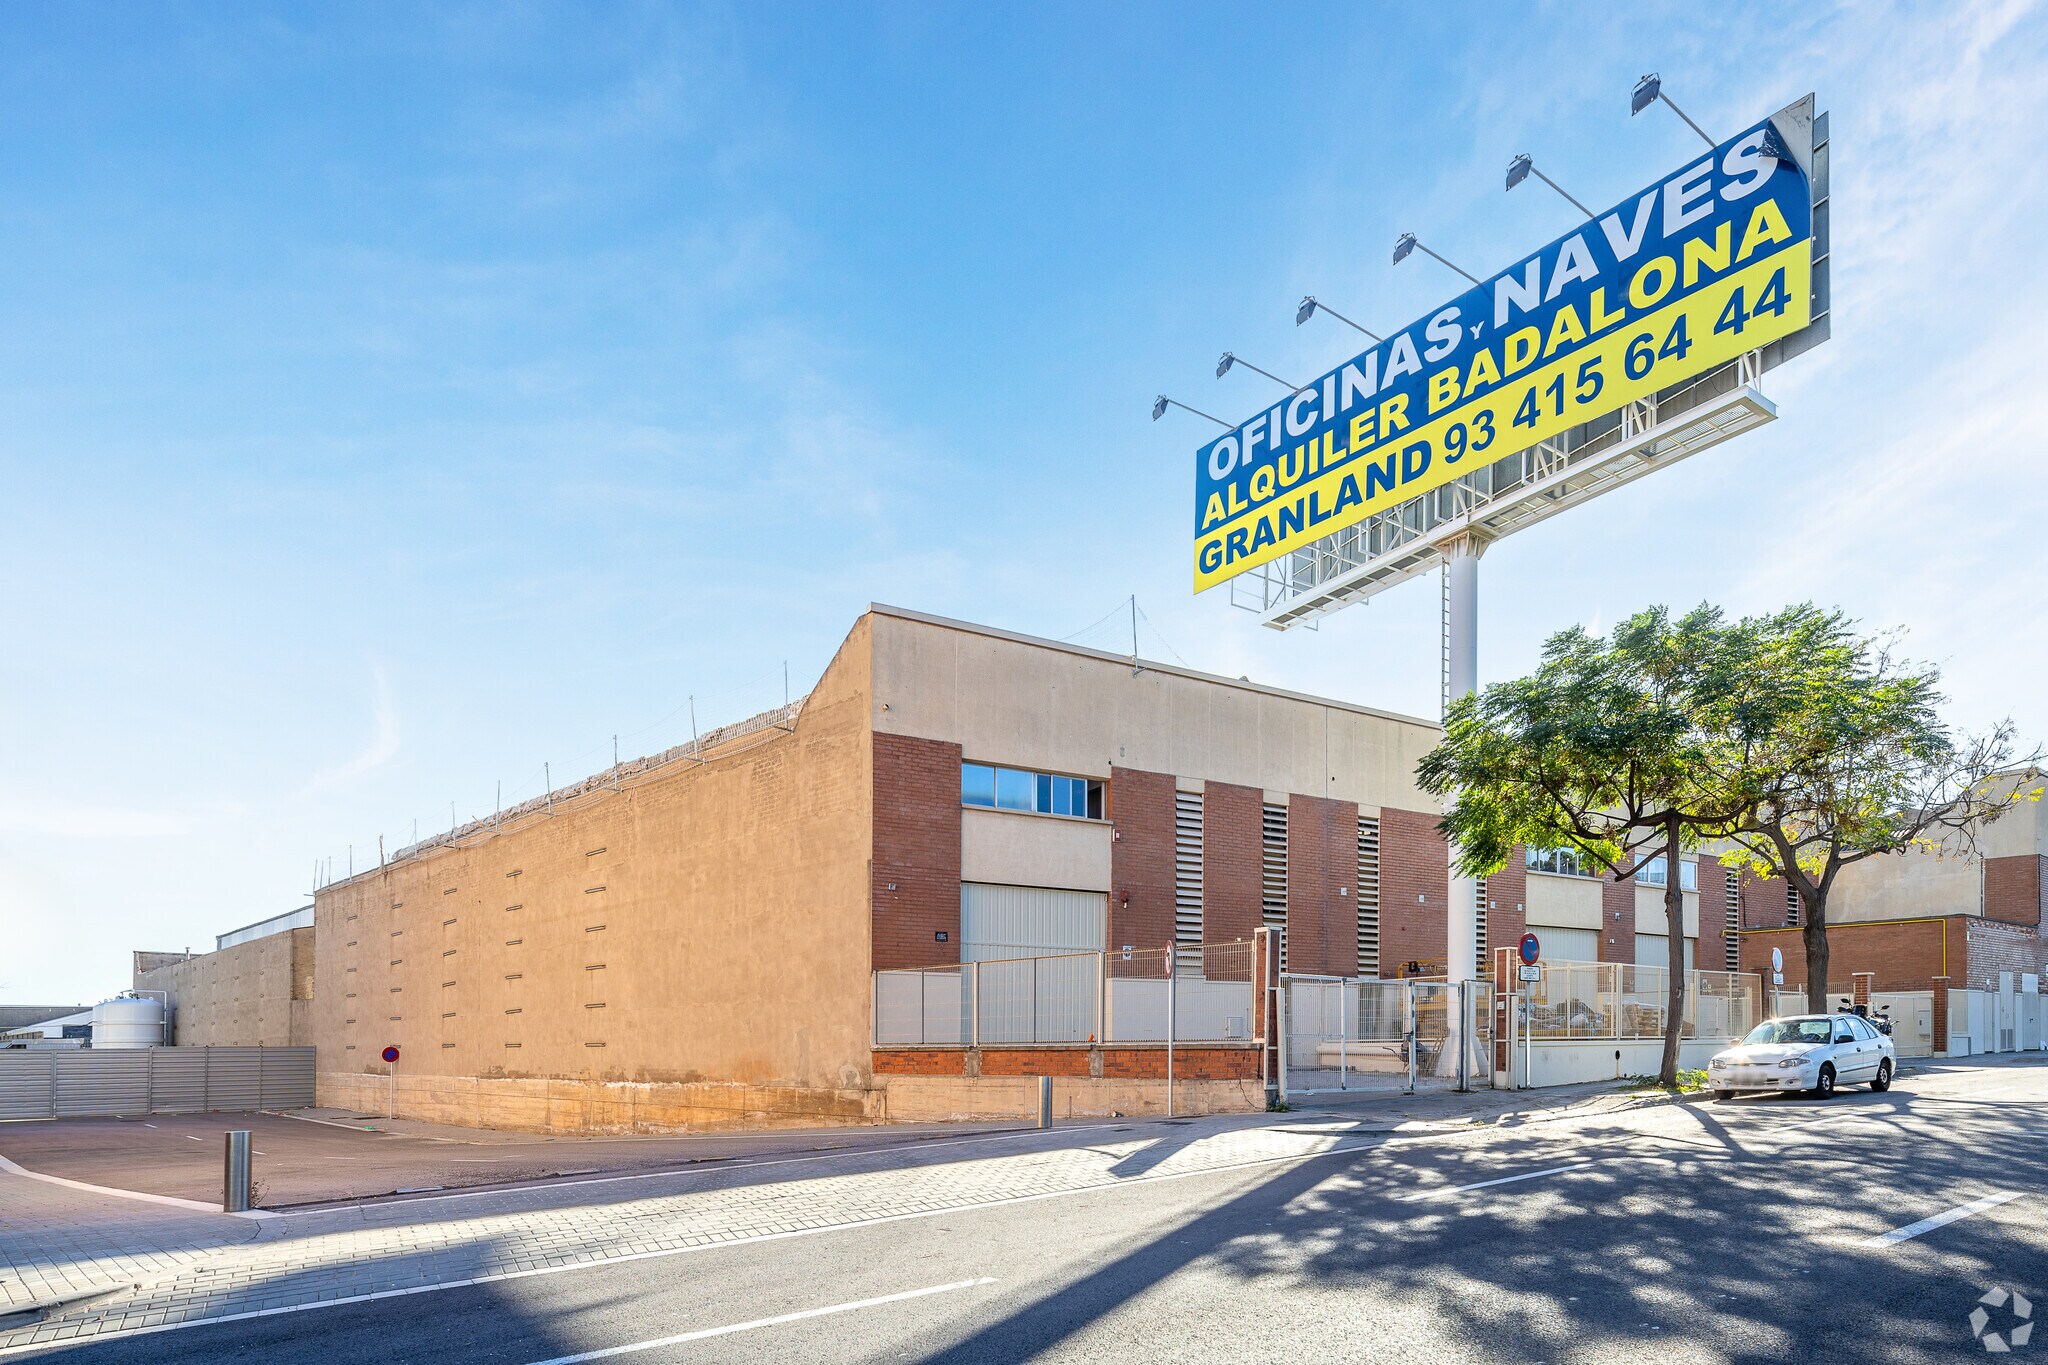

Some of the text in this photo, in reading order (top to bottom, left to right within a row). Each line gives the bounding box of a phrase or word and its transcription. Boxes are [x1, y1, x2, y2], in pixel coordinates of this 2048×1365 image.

[1199, 266, 1792, 575] GRANLAND 93 415 64 44
[1201, 198, 1792, 530] ALQUILER BADALONA
[1208, 128, 1778, 481] OFICINAS Y NAVES
